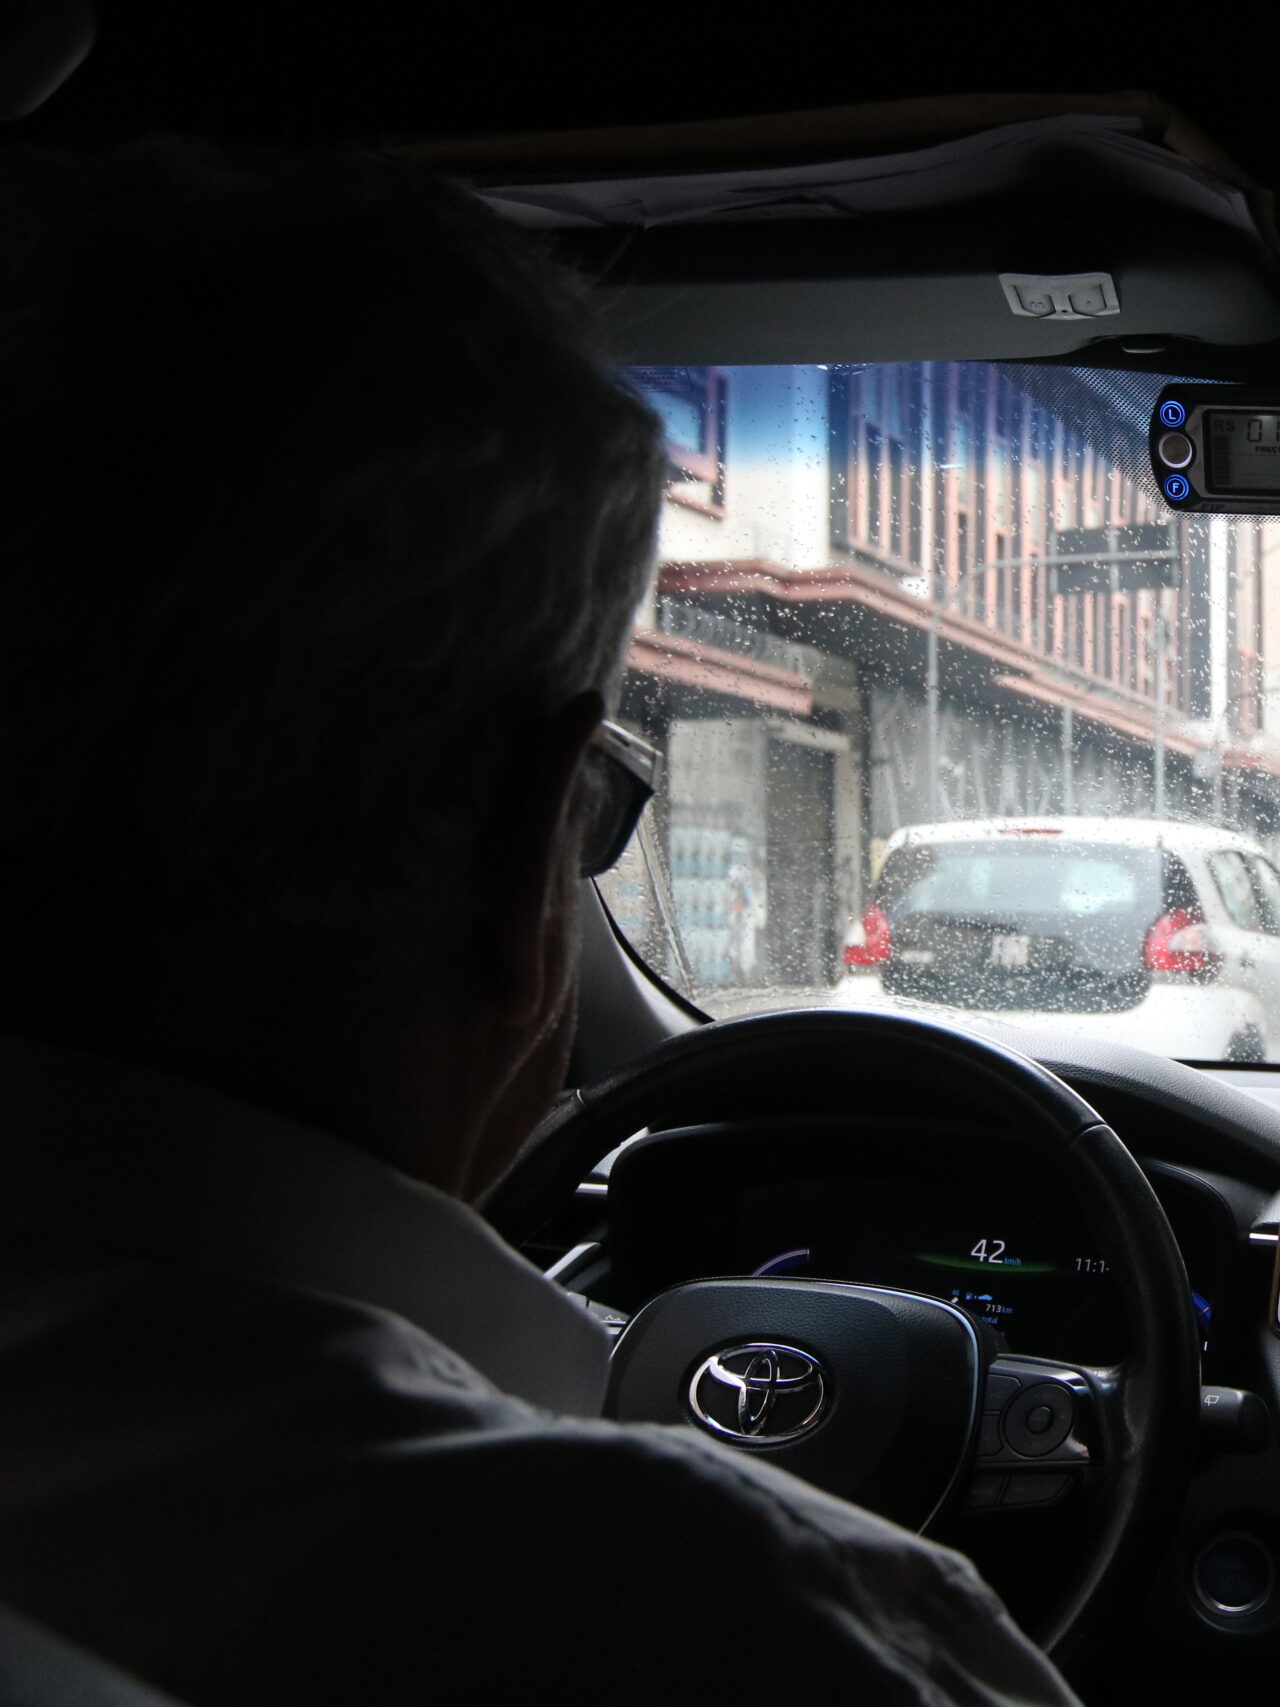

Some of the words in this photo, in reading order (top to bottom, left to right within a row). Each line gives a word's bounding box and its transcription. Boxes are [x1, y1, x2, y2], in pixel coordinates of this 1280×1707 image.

[1168, 409, 1176, 420] L
[1172, 482, 1180, 493] F
[970, 1239, 1006, 1264] 42
[1004, 1257, 1022, 1266] km/h
[1074, 1257, 1110, 1273] 11:1
[986, 1303, 1001, 1313] 713
